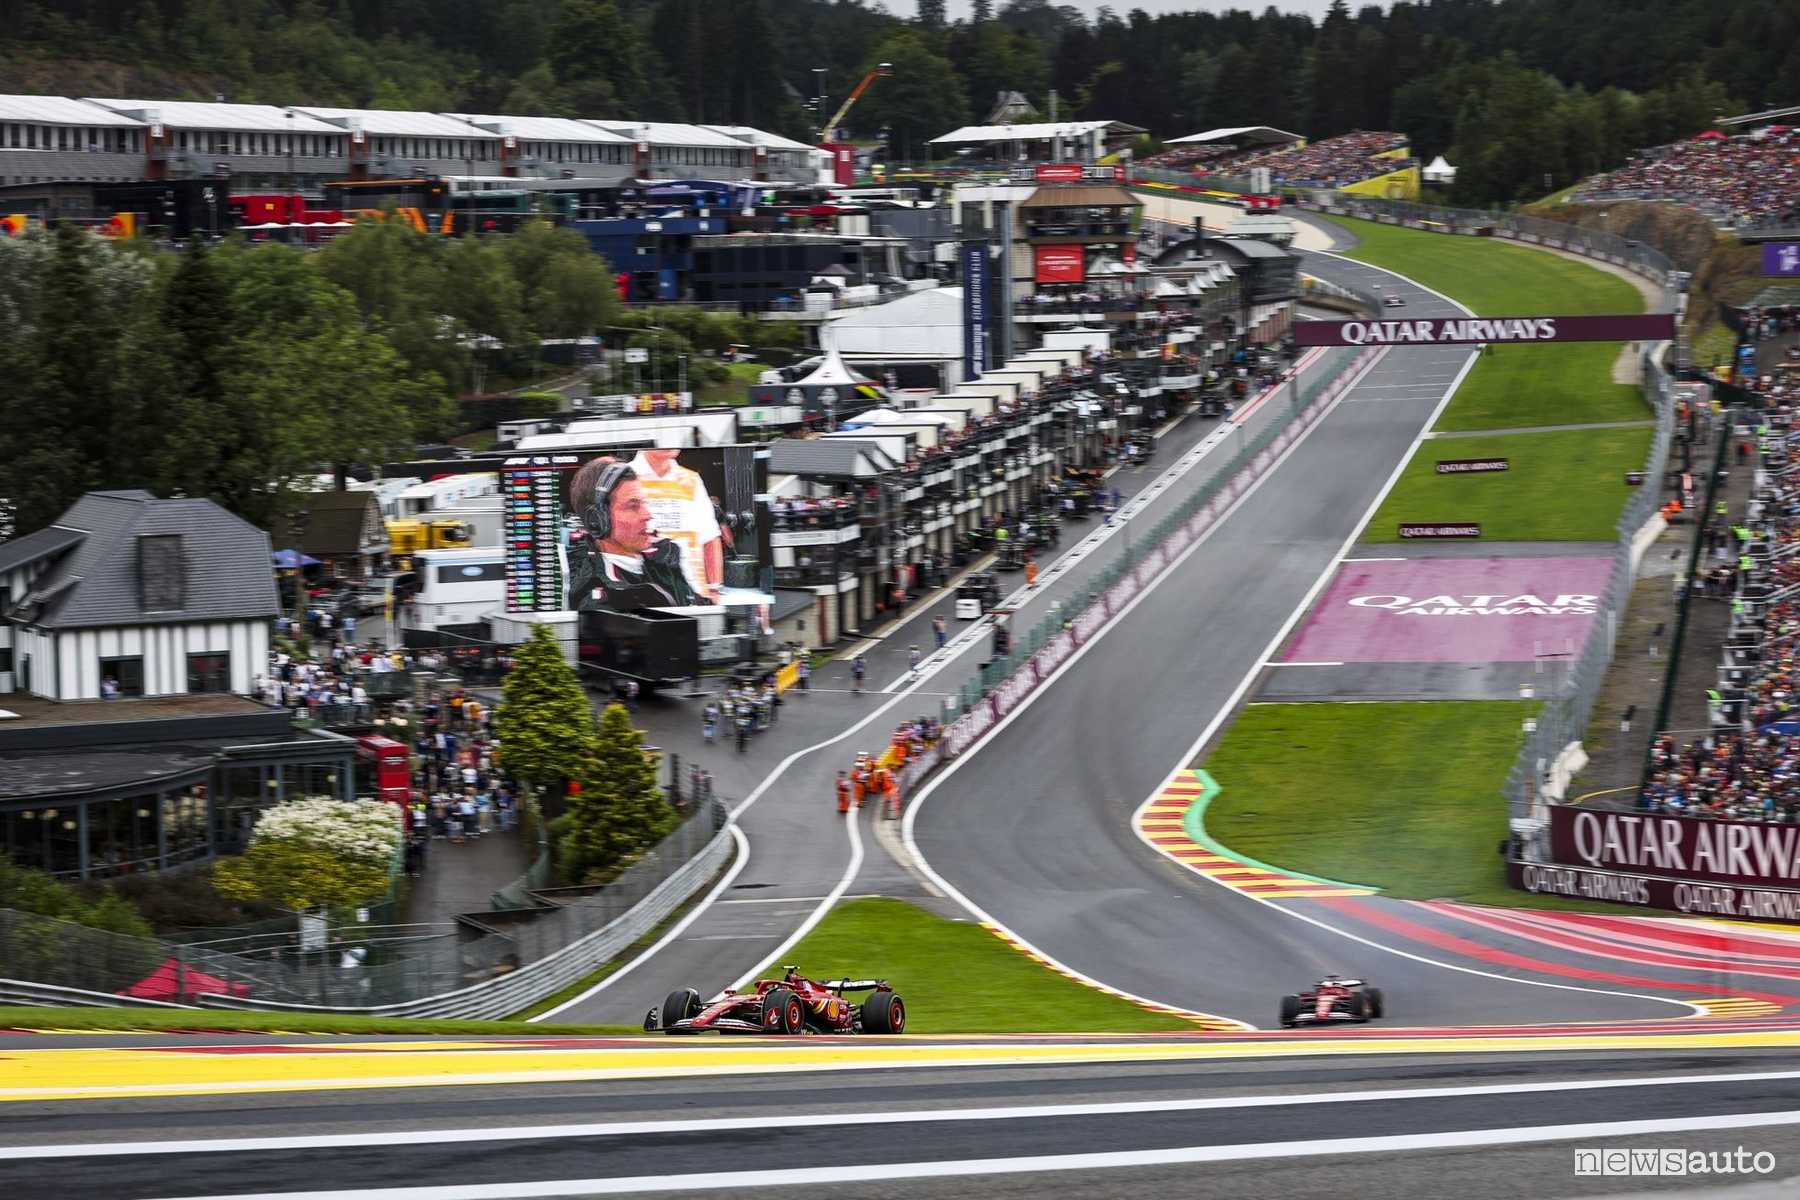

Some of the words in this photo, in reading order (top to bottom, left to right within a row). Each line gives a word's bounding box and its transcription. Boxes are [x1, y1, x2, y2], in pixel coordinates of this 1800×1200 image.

[1340, 321, 1435, 344] QATAR
[1438, 318, 1556, 341] AIRWAYS
[1347, 594, 1598, 608] QATAR
[1393, 605, 1598, 615] AIRWAYS
[1573, 812, 1687, 870] QATAR
[1522, 865, 1578, 895] QATAR
[1579, 873, 1649, 904] AIRWAYS
[1673, 884, 1736, 915] QATAR
